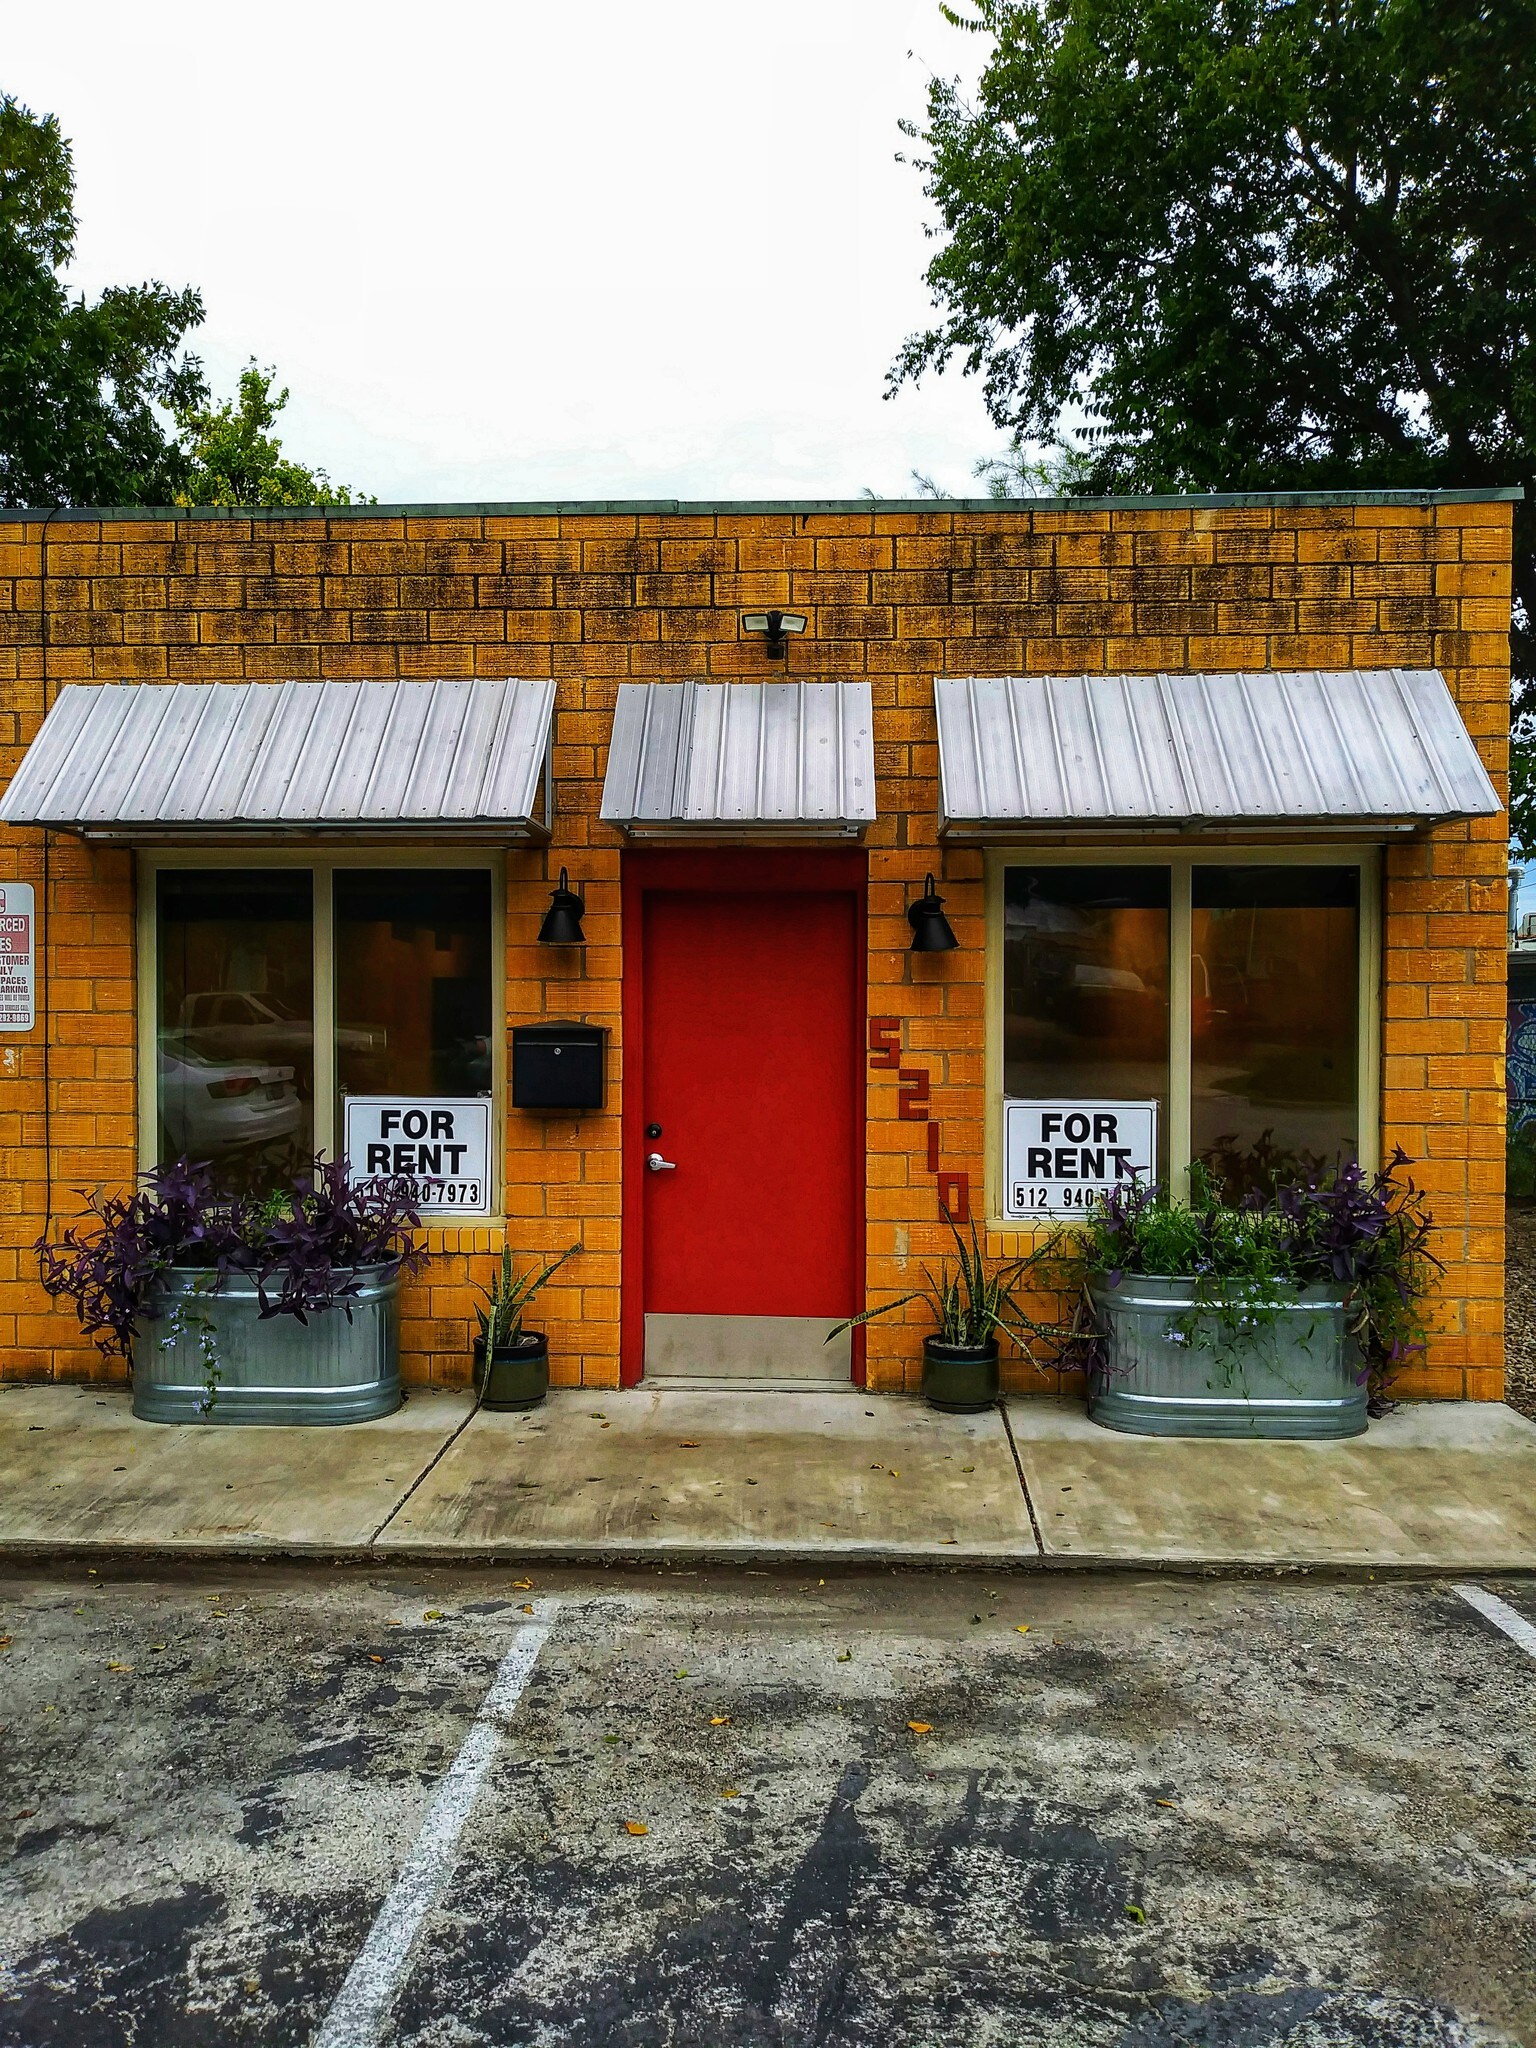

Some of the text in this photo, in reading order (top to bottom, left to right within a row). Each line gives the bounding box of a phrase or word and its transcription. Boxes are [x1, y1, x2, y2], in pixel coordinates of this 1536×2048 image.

[381, 1109, 455, 1140] FOR
[869, 1018, 969, 1223] 5210
[1041, 1112, 1118, 1144] FOR
[367, 1143, 467, 1175] RENT
[1027, 1147, 1132, 1179] RENT
[1016, 1187, 1048, 1207] 512
